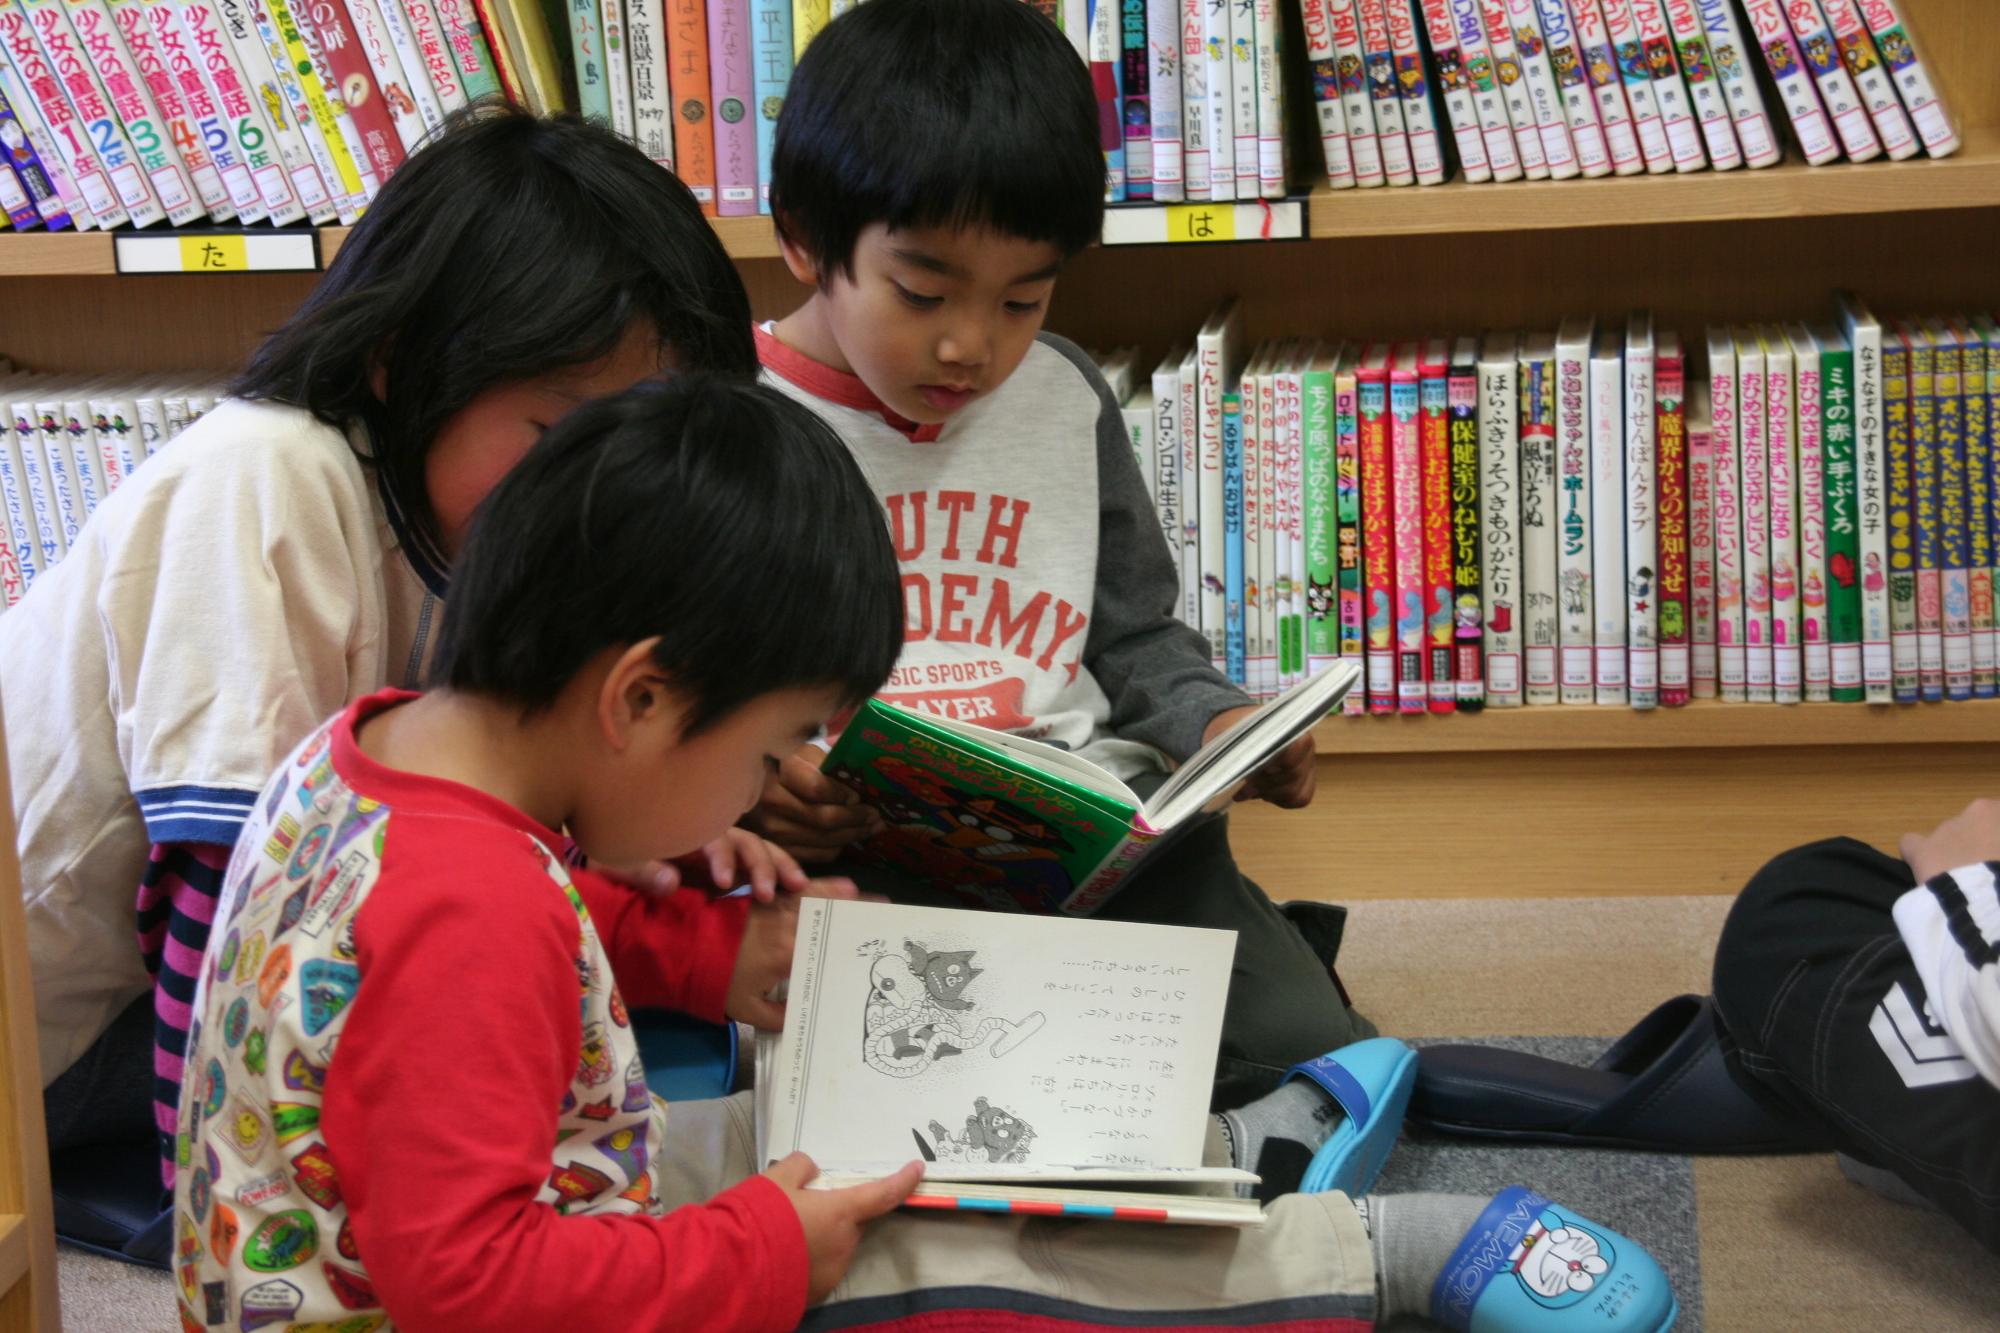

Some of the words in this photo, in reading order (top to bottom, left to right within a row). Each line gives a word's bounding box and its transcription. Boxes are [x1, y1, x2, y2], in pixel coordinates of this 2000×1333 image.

[202, 242, 226, 268] た
[1188, 212, 1214, 238] は
[1200, 351, 1221, 471] にんじゃごっこ
[1243, 383, 1255, 425] もりの
[1262, 387, 1273, 428] もりの
[1276, 379, 1288, 425] もりの
[1630, 373, 1653, 533] はりせんぼんクラブ
[1768, 371, 1791, 539] おひめさままいごになる
[1826, 366, 1853, 535] ミキの赤い手ぶくろ
[1859, 345, 1881, 536] なぞなぞのすきな女の子
[1225, 422, 1241, 534] るすばんおばけ
[1243, 438, 1258, 542] ゆうびんきょく
[1262, 439, 1274, 530] おかしやさん
[1452, 421, 1479, 586] 保健室のねむり姫
[1485, 374, 1514, 597] ほらふきうそつきものがたり
[1523, 441, 1544, 527] 風立ちぬ
[1657, 415, 1687, 592] 魔界からのお知らせ
[1712, 374, 1737, 568] おひめさまかいものにいく
[1742, 371, 1765, 557] おひめさまたからさがしにいく
[915, 695, 997, 722] AYER
[926, 660, 1004, 684] SPORTS
[1109, 1033, 1178, 1048] たたいたり
